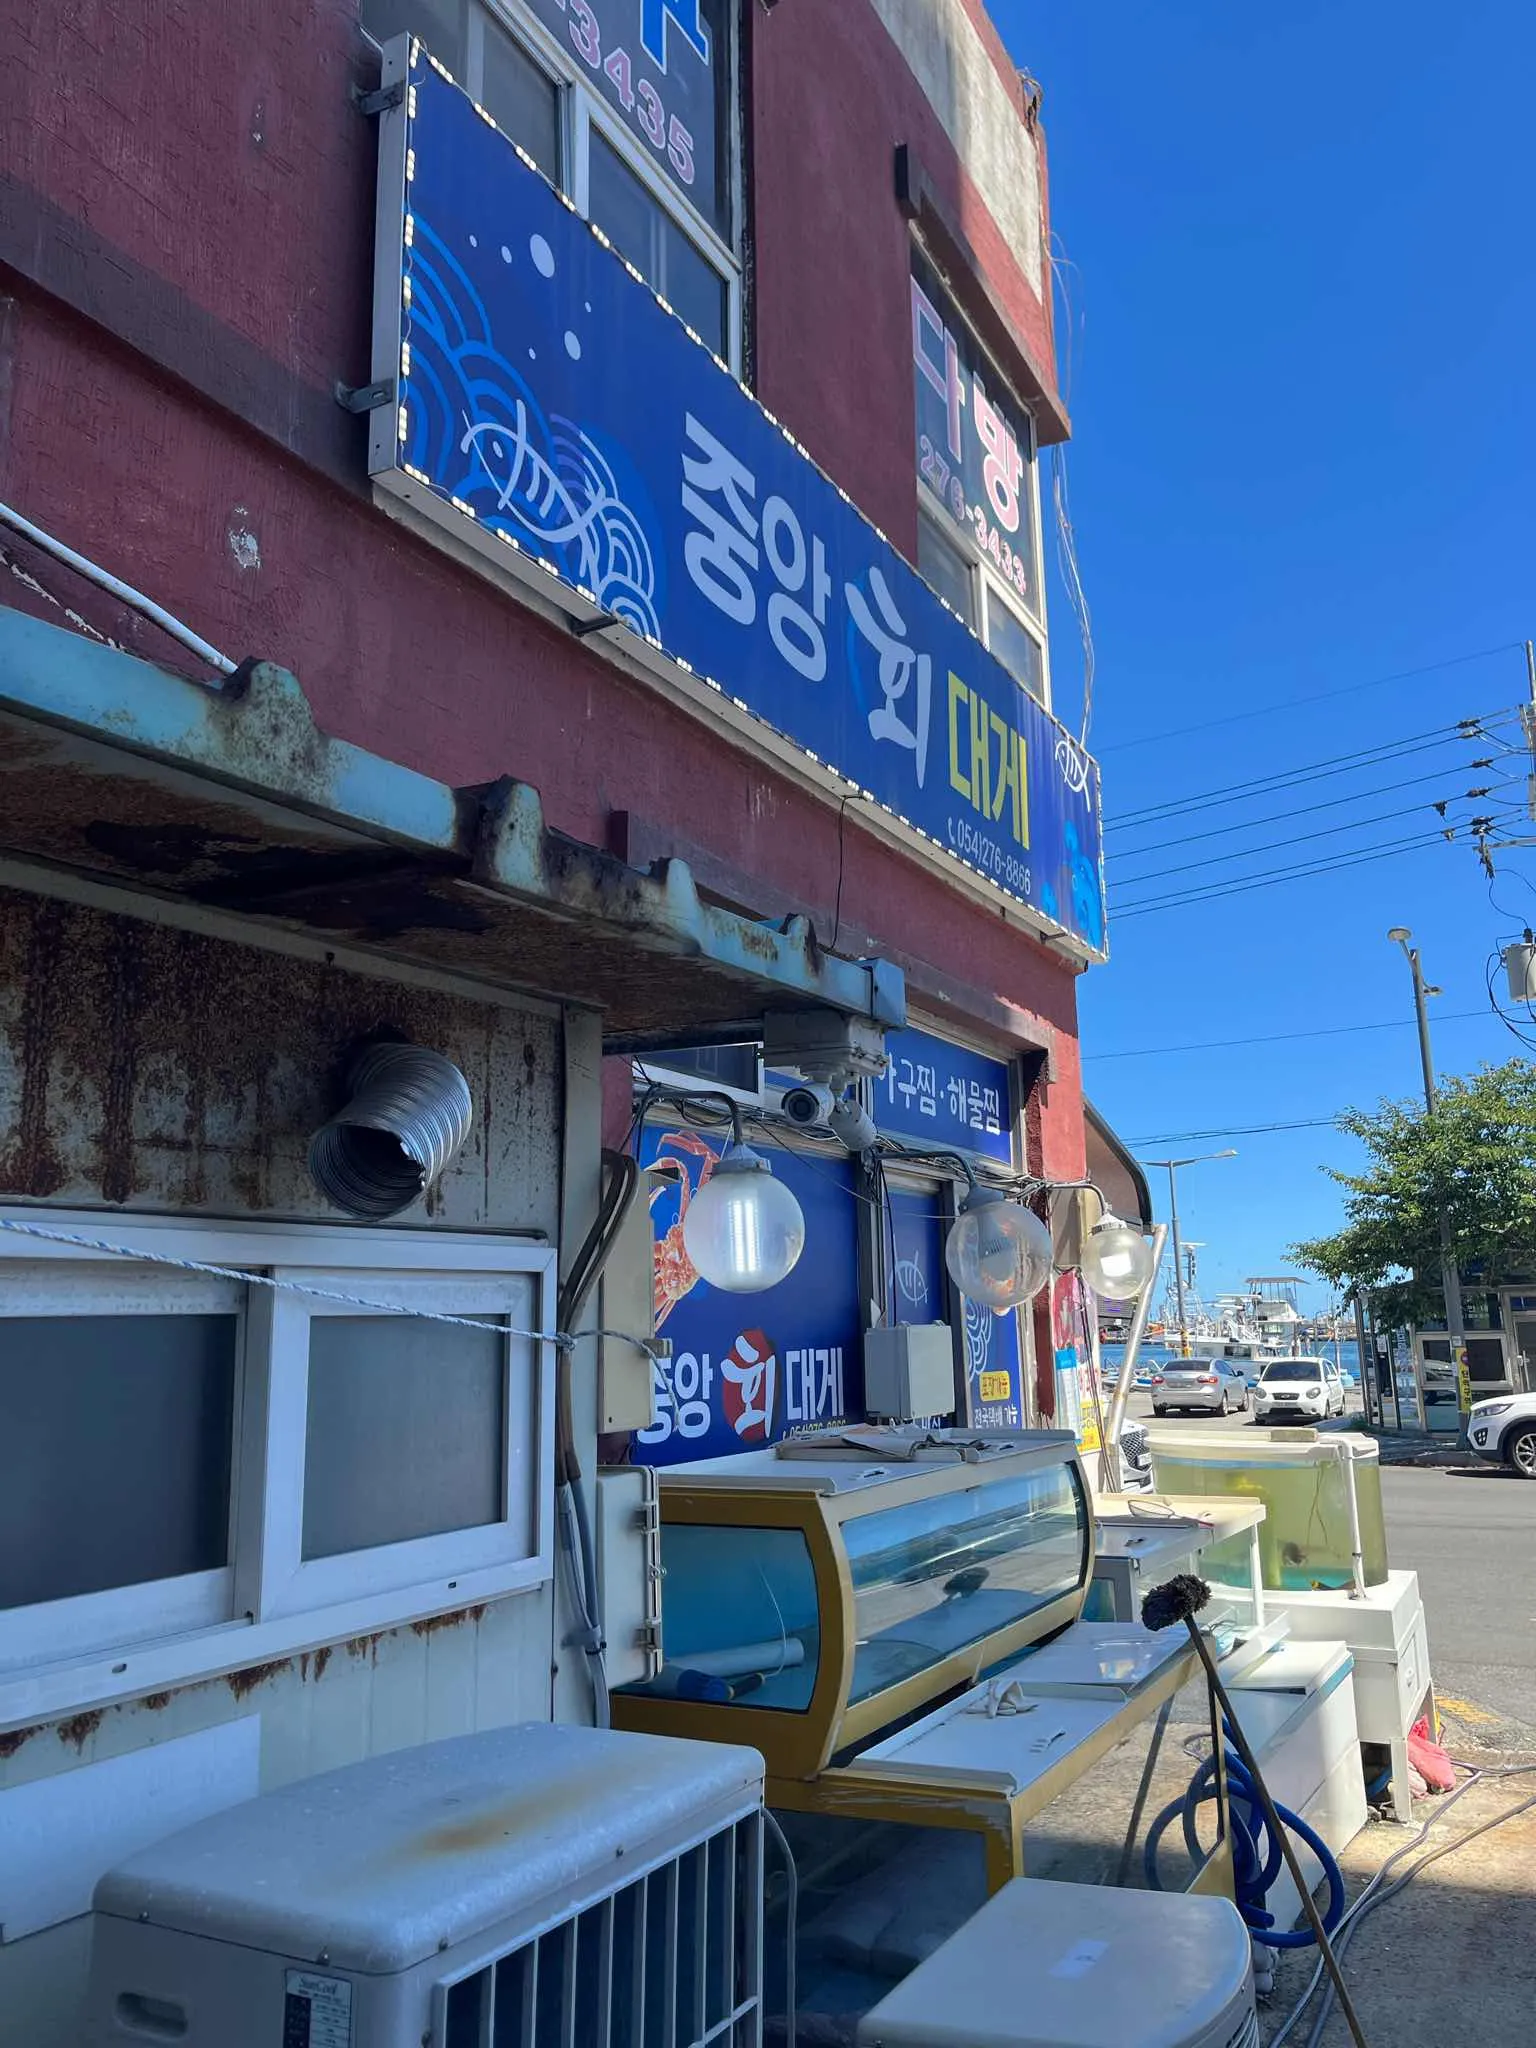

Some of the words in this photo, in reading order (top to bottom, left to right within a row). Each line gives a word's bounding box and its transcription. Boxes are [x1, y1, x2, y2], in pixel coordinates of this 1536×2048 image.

[948, 670, 1029, 850] 대게
[957, 818, 1031, 895] 054)276-8866
[785, 1347, 845, 1421] 대게
